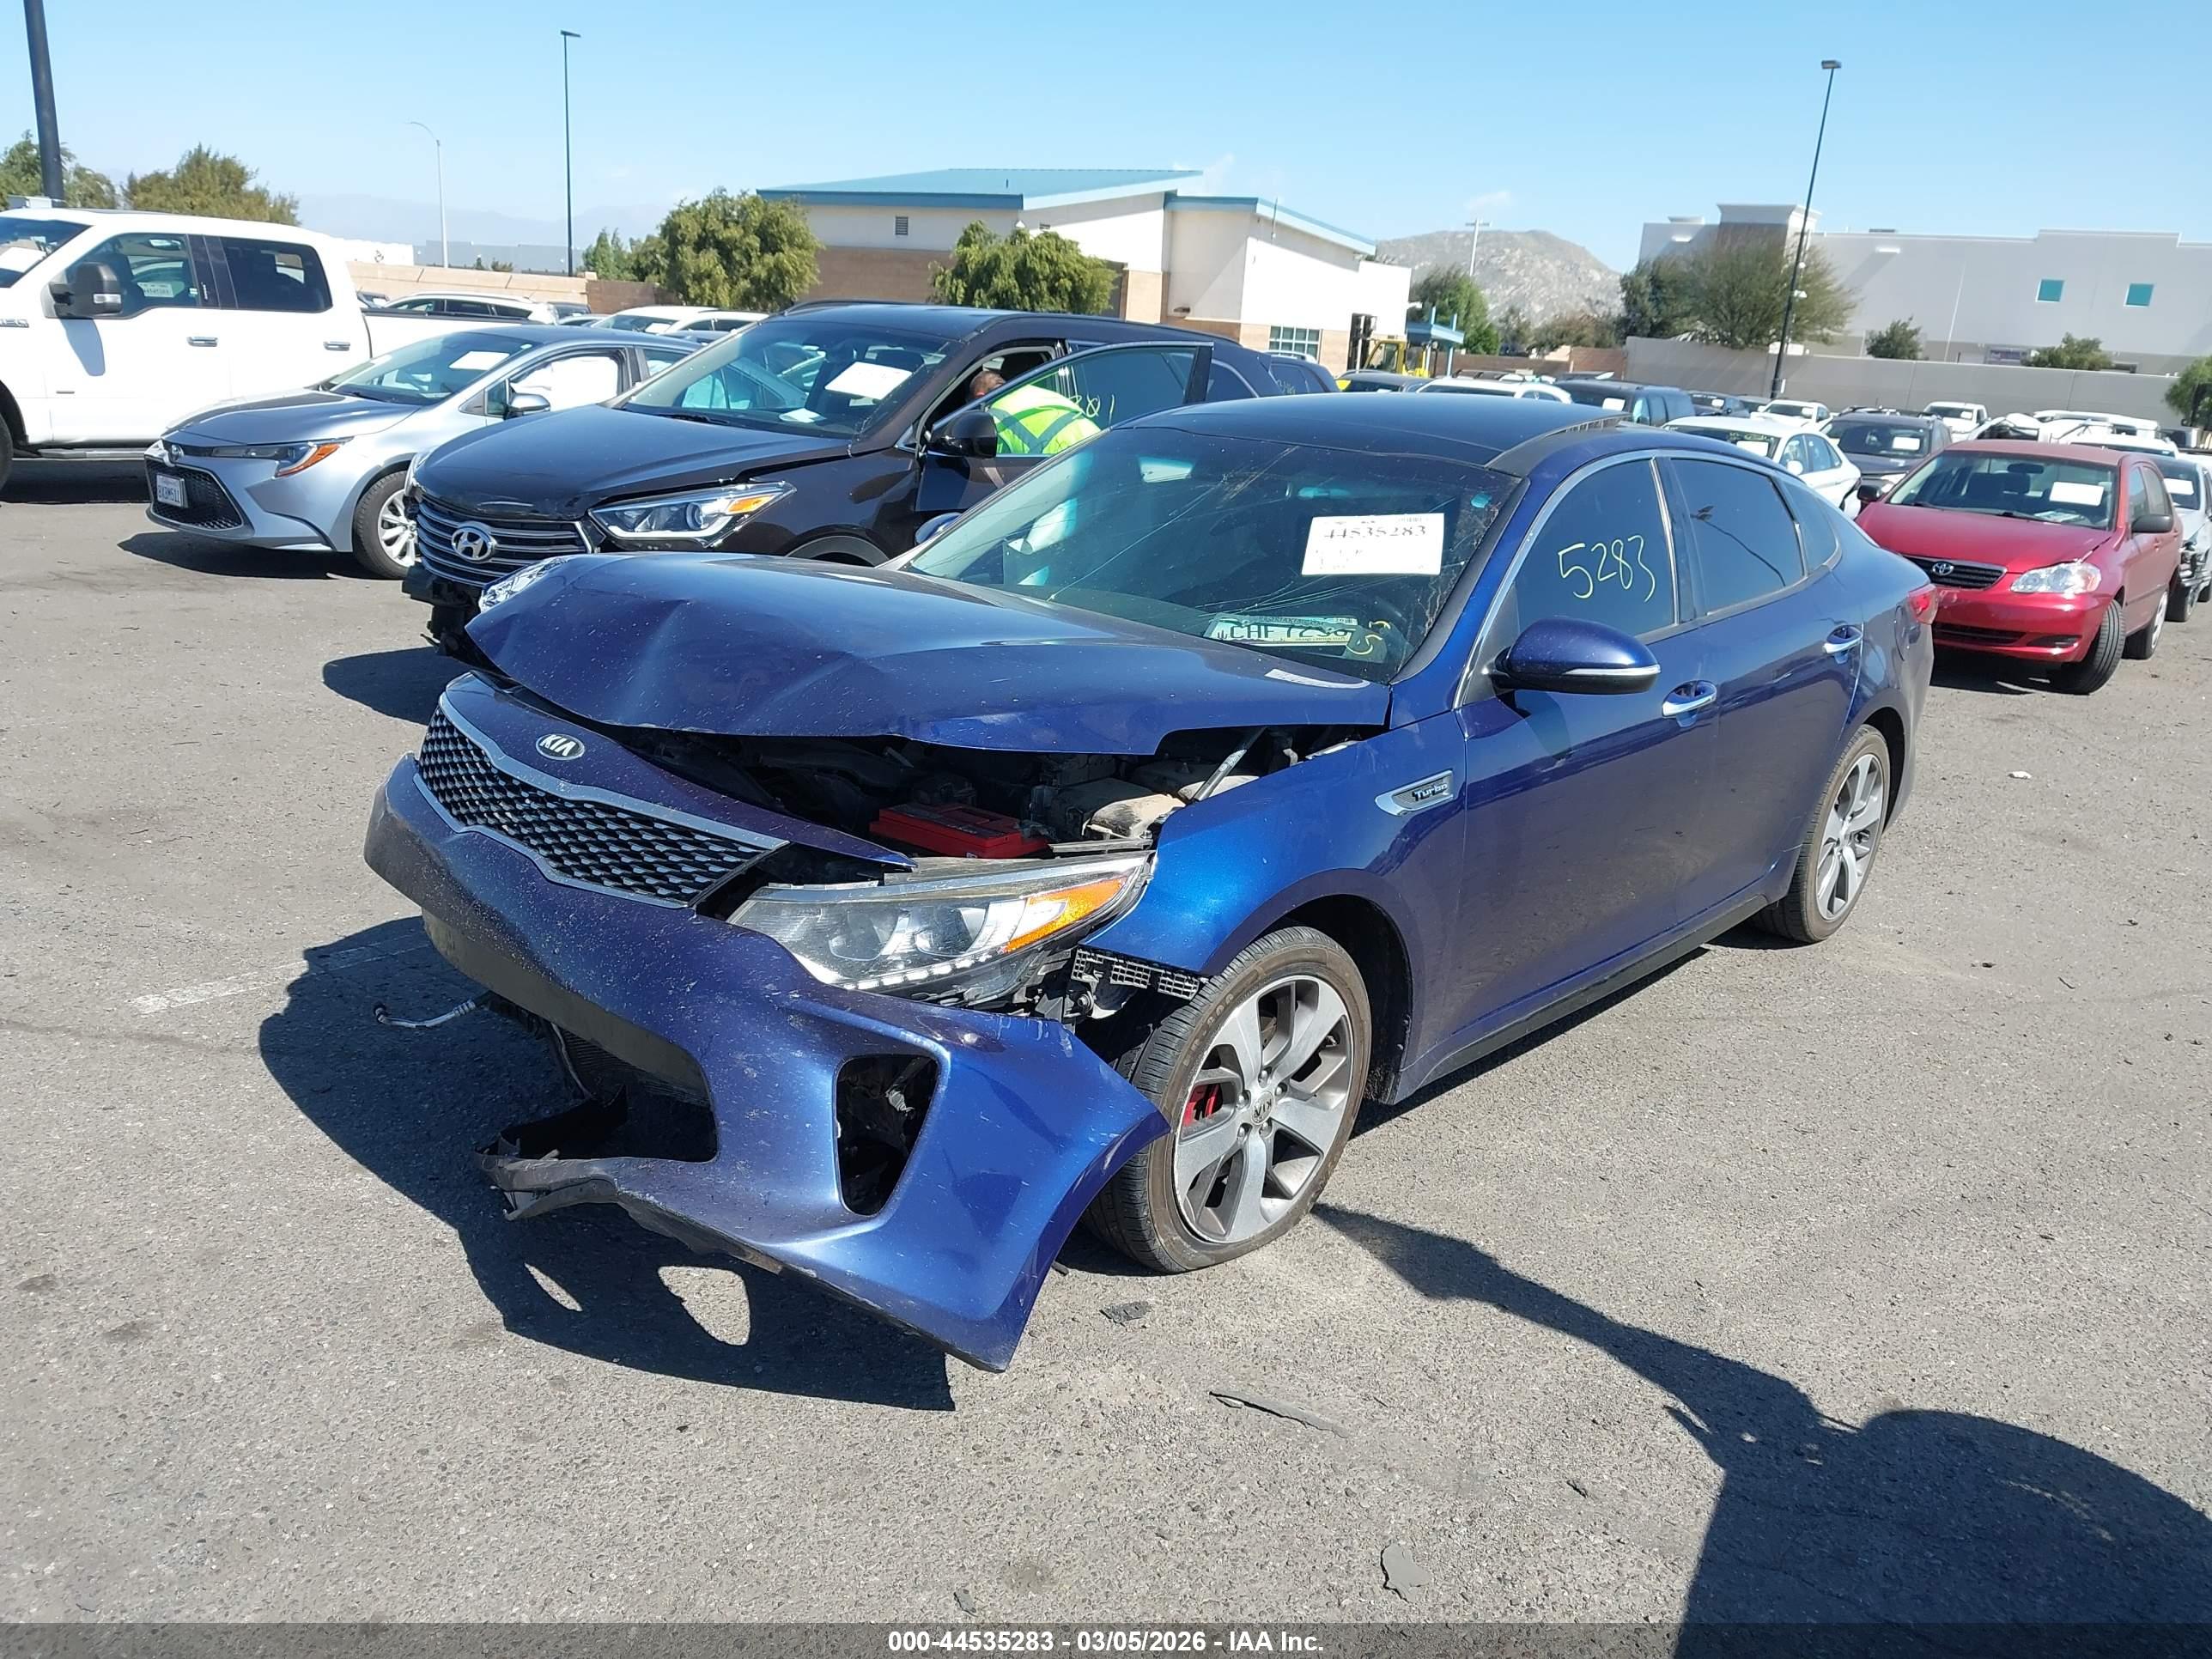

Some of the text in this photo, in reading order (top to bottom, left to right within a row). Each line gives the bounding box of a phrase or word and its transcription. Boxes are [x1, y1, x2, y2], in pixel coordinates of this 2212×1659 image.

[1323, 525, 1426, 539] 44535283
[1558, 534, 1656, 603] 5283
[538, 734, 577, 757] KIA
[1413, 783, 1449, 801] Turbo
